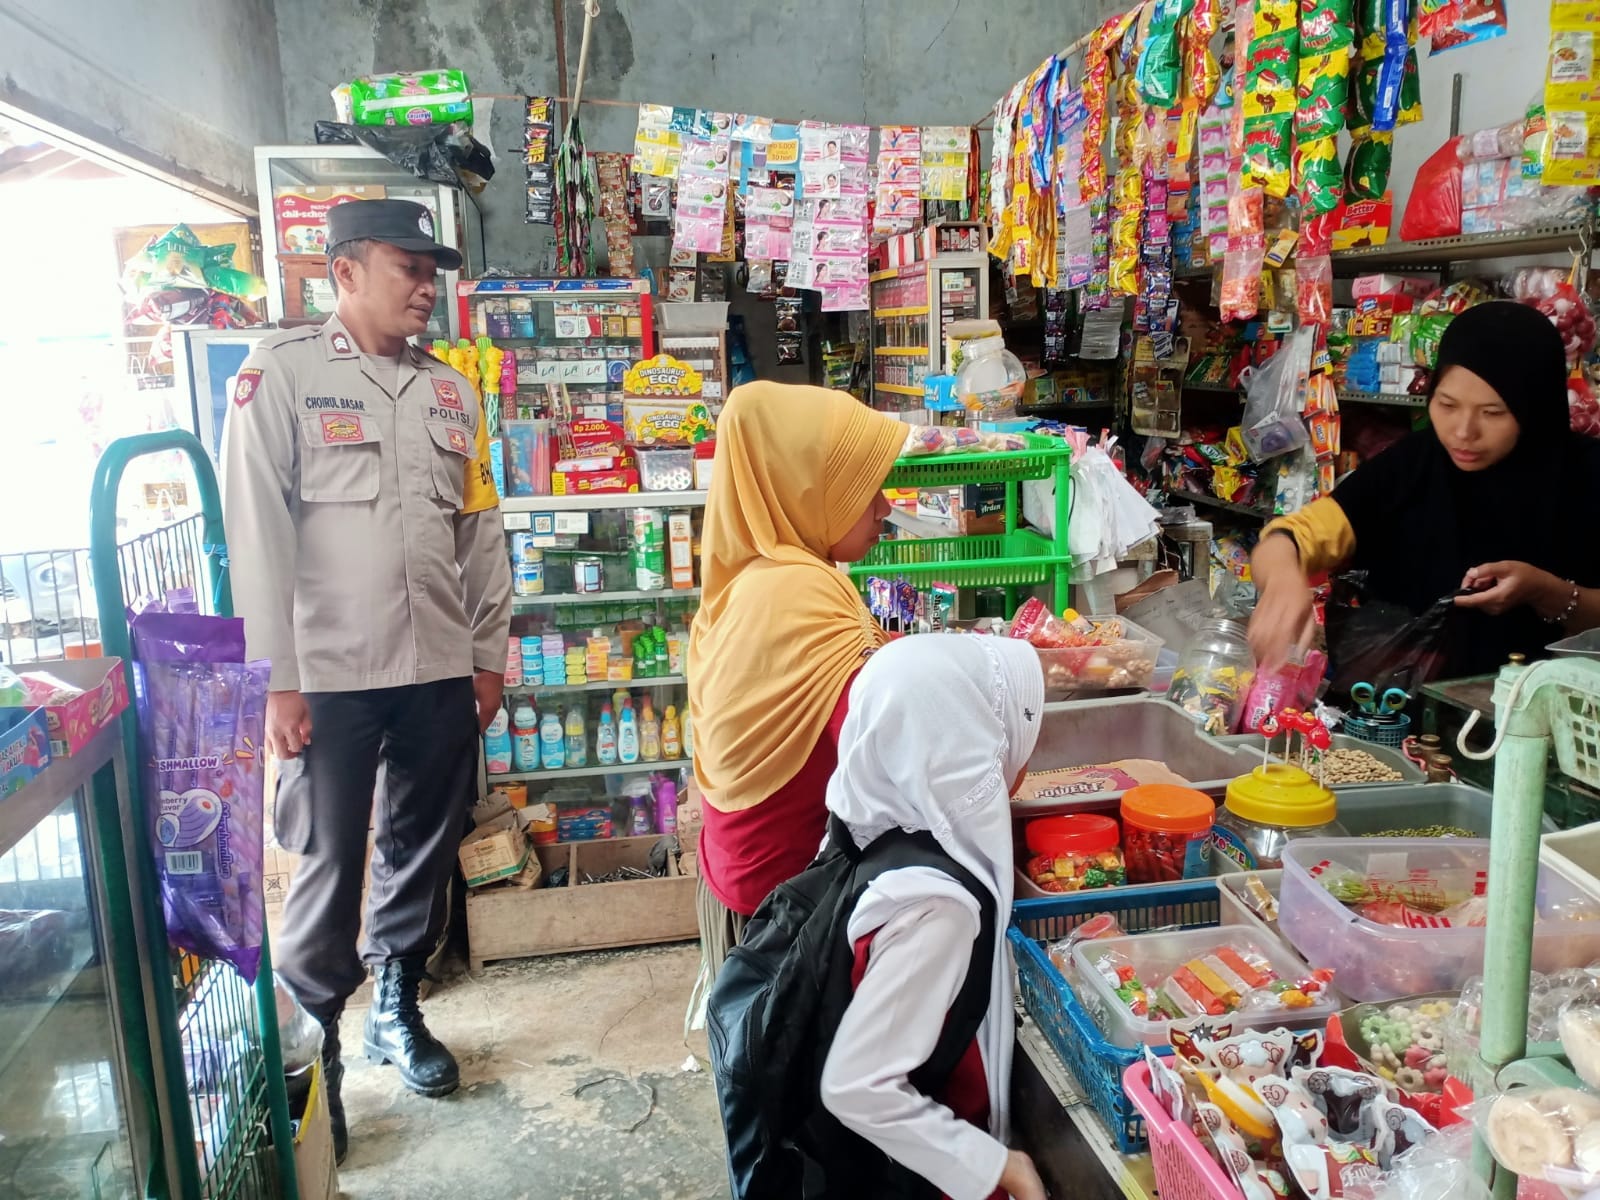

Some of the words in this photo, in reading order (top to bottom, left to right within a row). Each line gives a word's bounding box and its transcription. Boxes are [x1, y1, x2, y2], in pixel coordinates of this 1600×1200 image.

[541, 366, 555, 377] LA
[564, 366, 578, 377] LA
[586, 365, 601, 376] LA
[639, 367, 686, 377] DINOSAURUS
[649, 375, 679, 385] EGG
[305, 397, 339, 409] CHOIRUL
[429, 407, 471, 424] POLISI
